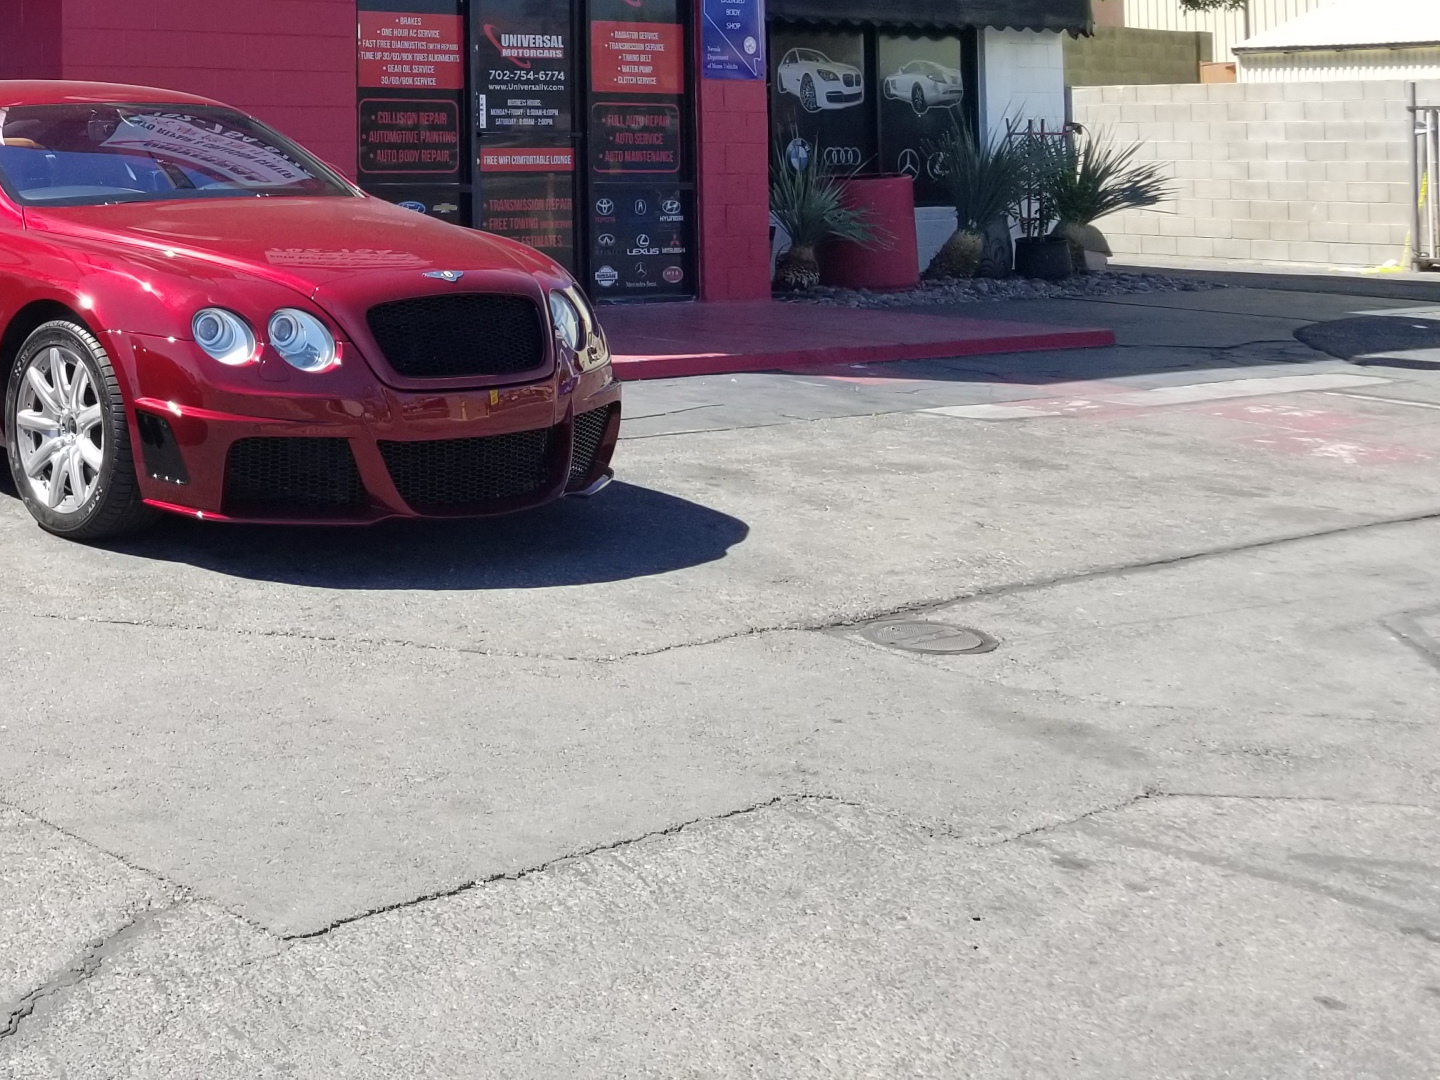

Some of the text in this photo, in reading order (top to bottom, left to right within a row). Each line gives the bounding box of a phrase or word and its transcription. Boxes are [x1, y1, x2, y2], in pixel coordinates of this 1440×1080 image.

[400, 17, 421, 25] BRAKES
[382, 28, 440, 38] ONE HOUR AC SERVICE
[362, 40, 376, 48] FAST
[377, 40, 390, 48] FREE
[392, 41, 426, 49] DIAGNOSTICS
[501, 34, 564, 48] UNIVERSAL
[609, 42, 644, 50] TRANSMISSION
[361, 52, 374, 60] TUNE
[428, 54, 460, 62] ALIGNMENTS
[502, 48, 563, 58] MOTORCARS
[412, 66, 434, 74] SERVICE
[489, 70, 565, 80] 702-754-6774
[414, 78, 436, 86] SERVICE
[378, 112, 446, 124] COLLISION REPAIR
[608, 114, 670, 127] FULL AUTO REPAIR
[368, 130, 456, 144] AUTOMOTIVE PAINTING
[615, 133, 664, 144] AUTO SERVICE
[376, 150, 450, 162] AUTO BODY REPAIR
[484, 155, 572, 164] FREE WIFI COMFORTABLE LOUNGE
[605, 150, 674, 162] AUTO MAINTENANCE
[489, 198, 572, 211] TRANSMISSION REPAIR
[489, 218, 508, 230] FREE
[509, 218, 538, 229] TOWING
[521, 234, 562, 248] ESTIMATES
